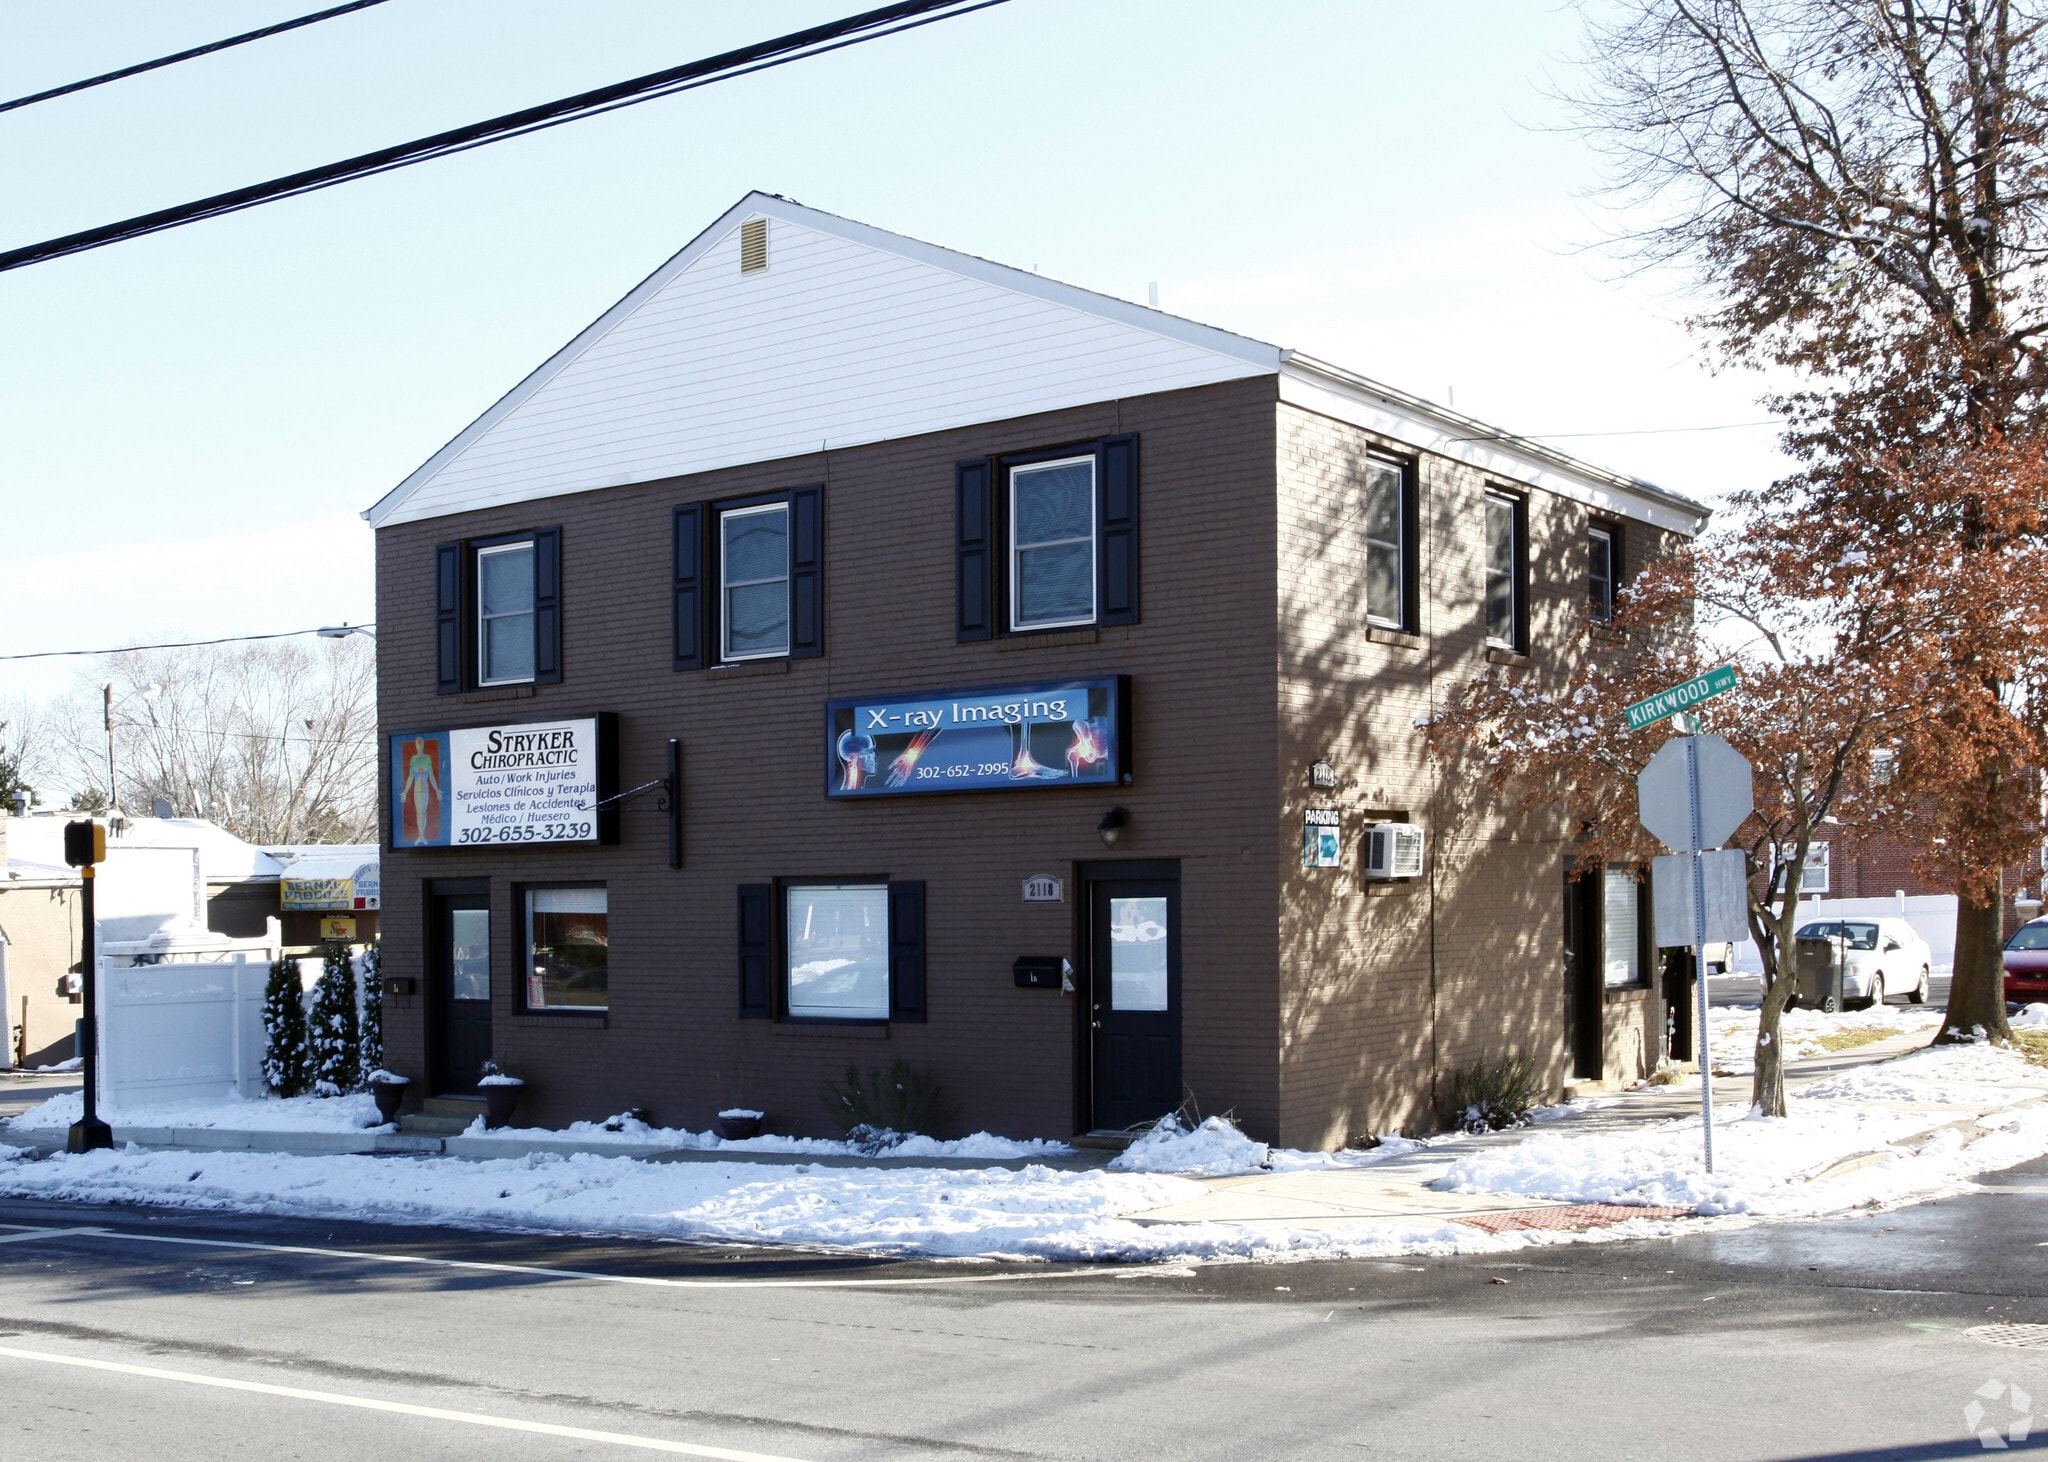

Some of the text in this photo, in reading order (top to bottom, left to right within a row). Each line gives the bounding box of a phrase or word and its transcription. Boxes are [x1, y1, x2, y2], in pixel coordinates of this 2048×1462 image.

[1630, 675, 1732, 726] KIRKWOOD HWY
[867, 698, 1069, 729] X-ray Imaging
[487, 730, 575, 754] STRYKER
[471, 749, 578, 770] CHIROPRACTIC
[535, 770, 576, 783] Injuries
[916, 762, 1009, 780] 302-652-2995
[456, 783, 596, 800] Servicios Clínicos y Terapia
[466, 798, 587, 814] Lesiones de Accidentes
[481, 811, 517, 825] Médico
[527, 811, 571, 823] Huesero
[1305, 809, 1339, 825] PARKING
[458, 822, 592, 844] 302-655-3239
[1029, 882, 1054, 897] 2118
